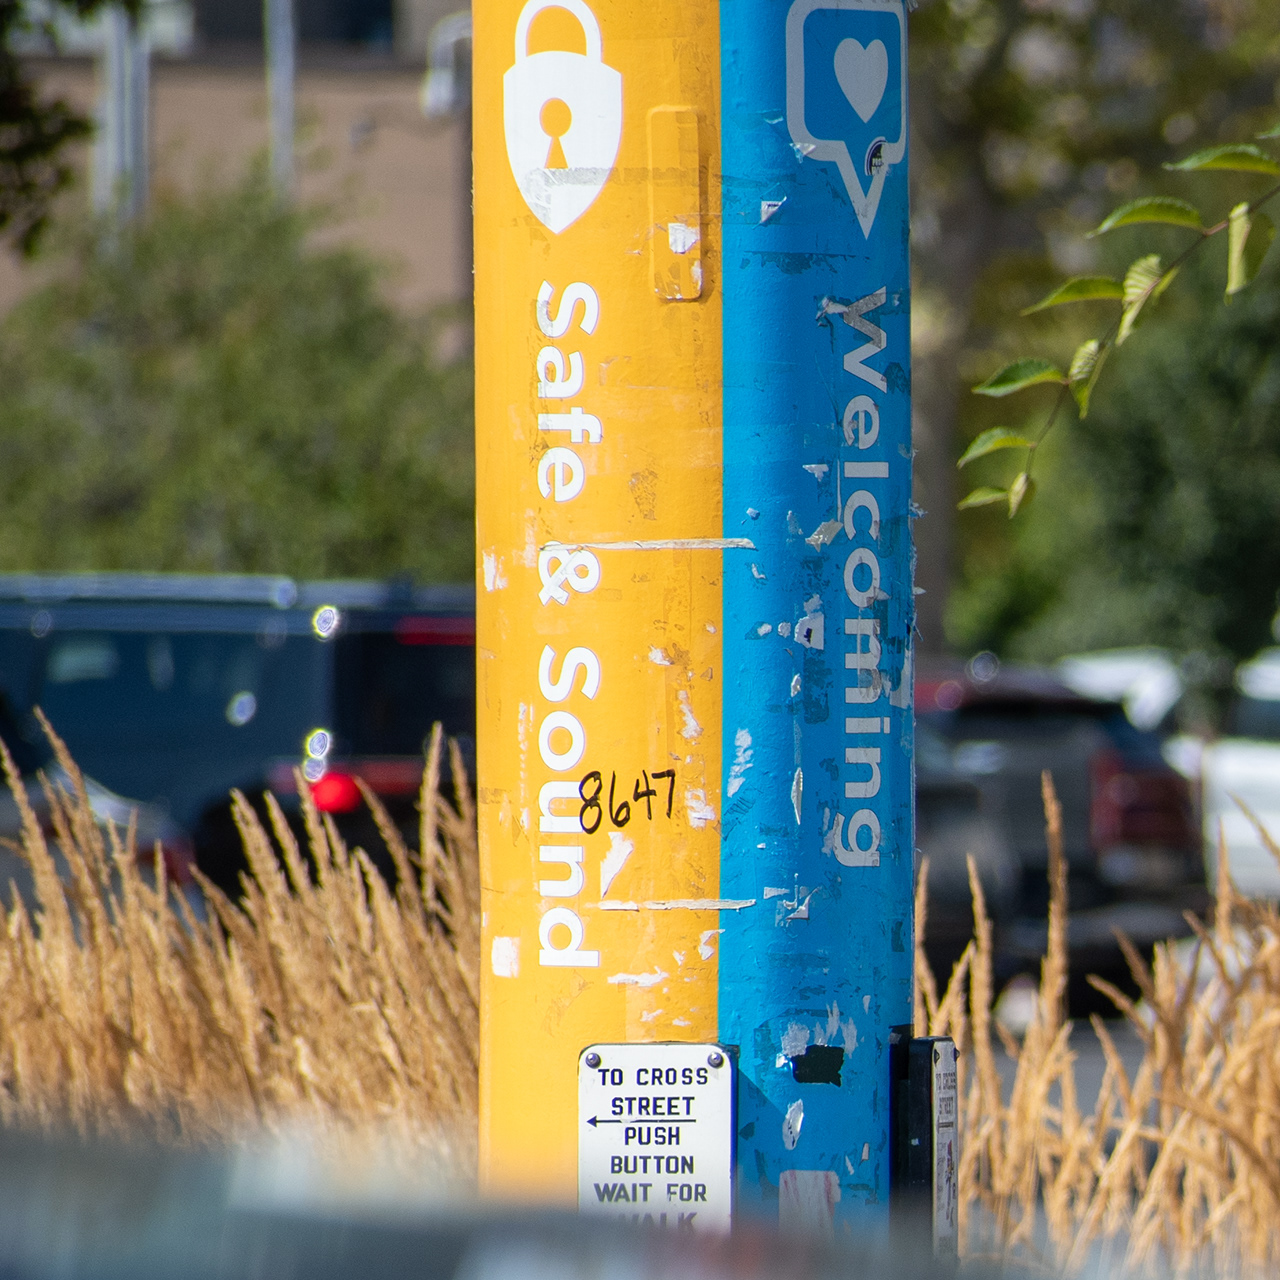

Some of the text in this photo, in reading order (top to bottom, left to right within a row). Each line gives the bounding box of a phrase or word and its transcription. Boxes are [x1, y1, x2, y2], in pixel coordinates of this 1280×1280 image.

[834, 285, 891, 868] Welcoming
[536, 280, 603, 968] Safe & Sound
[578, 769, 677, 834] 8647
[597, 1067, 708, 1086] TO CROSS
[611, 1096, 695, 1116] STREET
[624, 1126, 680, 1146] PUSH
[610, 1155, 694, 1174] BUTTON
[593, 1182, 708, 1203] WAIT FOR
